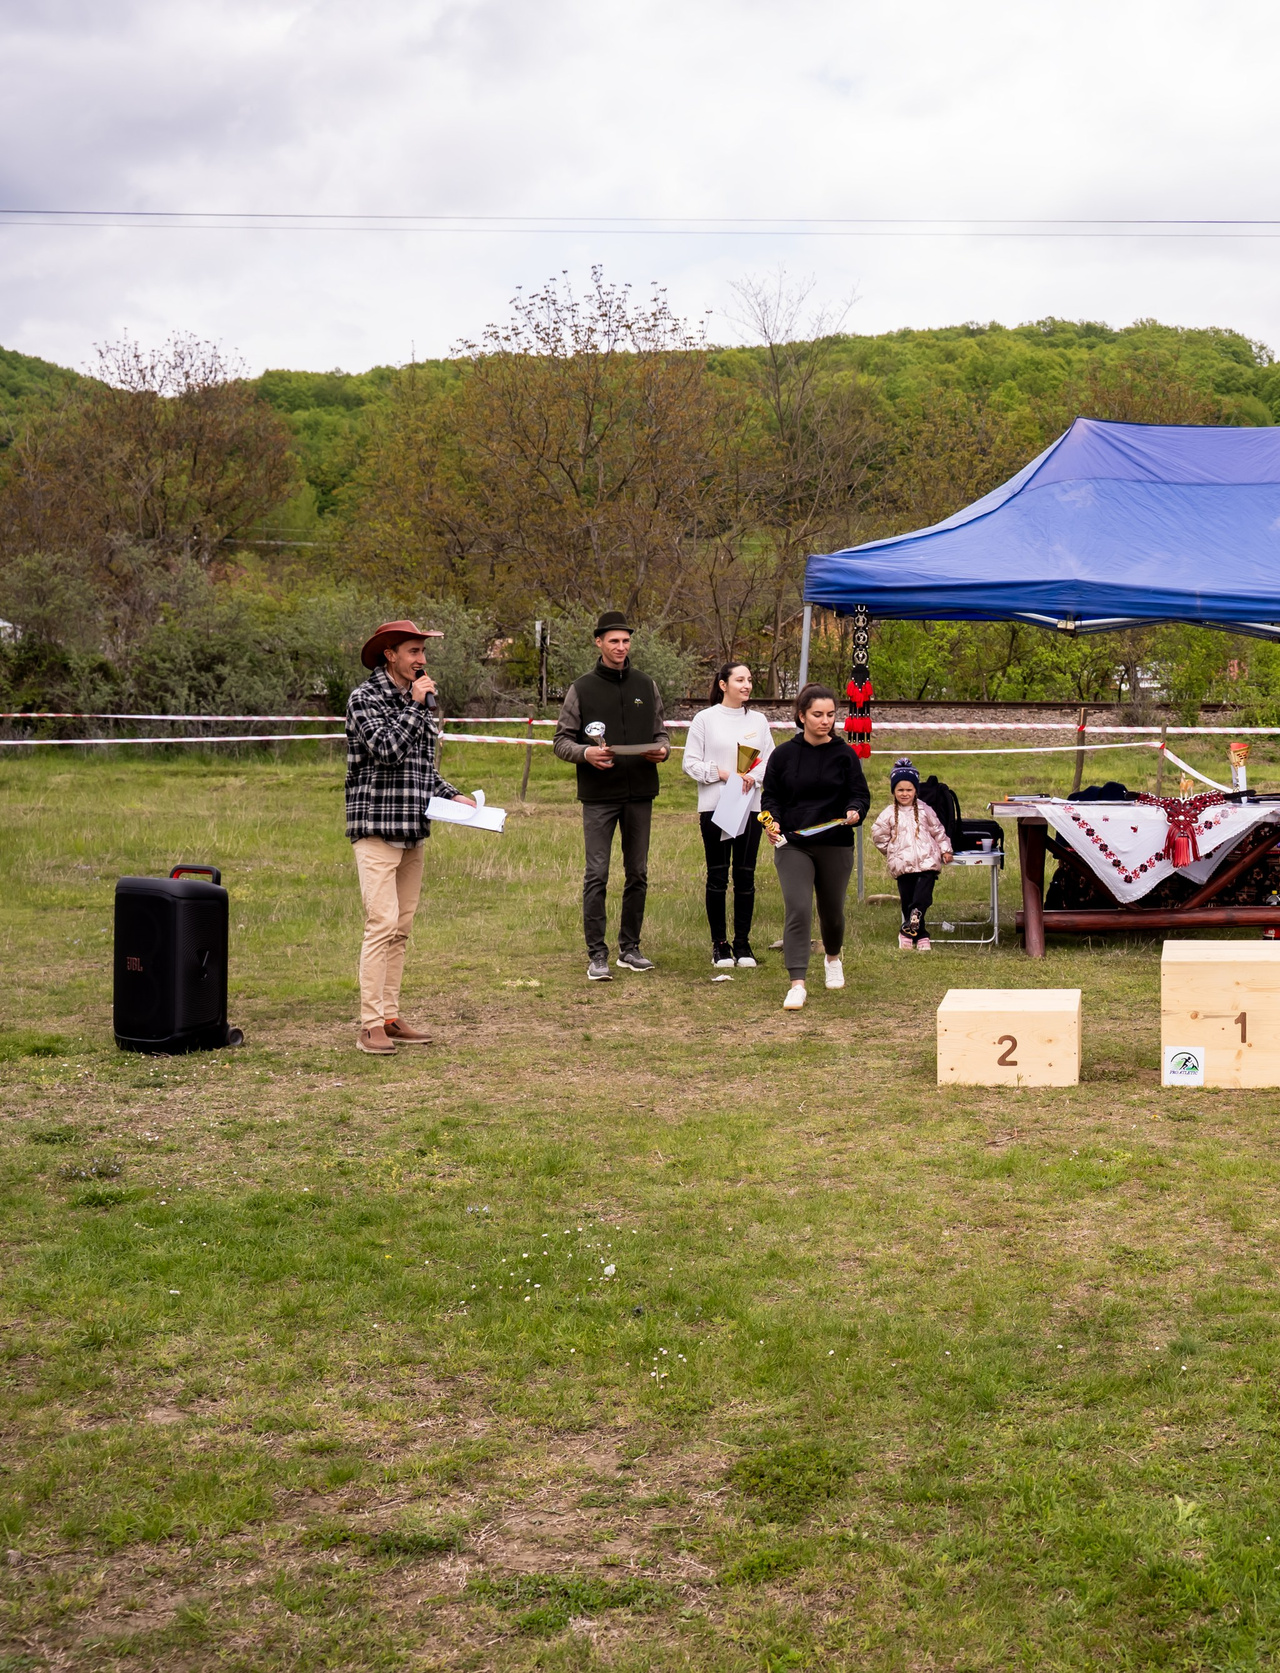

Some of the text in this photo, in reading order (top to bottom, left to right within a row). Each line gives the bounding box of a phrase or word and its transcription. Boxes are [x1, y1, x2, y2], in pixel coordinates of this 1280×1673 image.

[126, 956, 143, 971] JBL
[1234, 1011, 1247, 1044] 1
[997, 1034, 1018, 1067] 2
